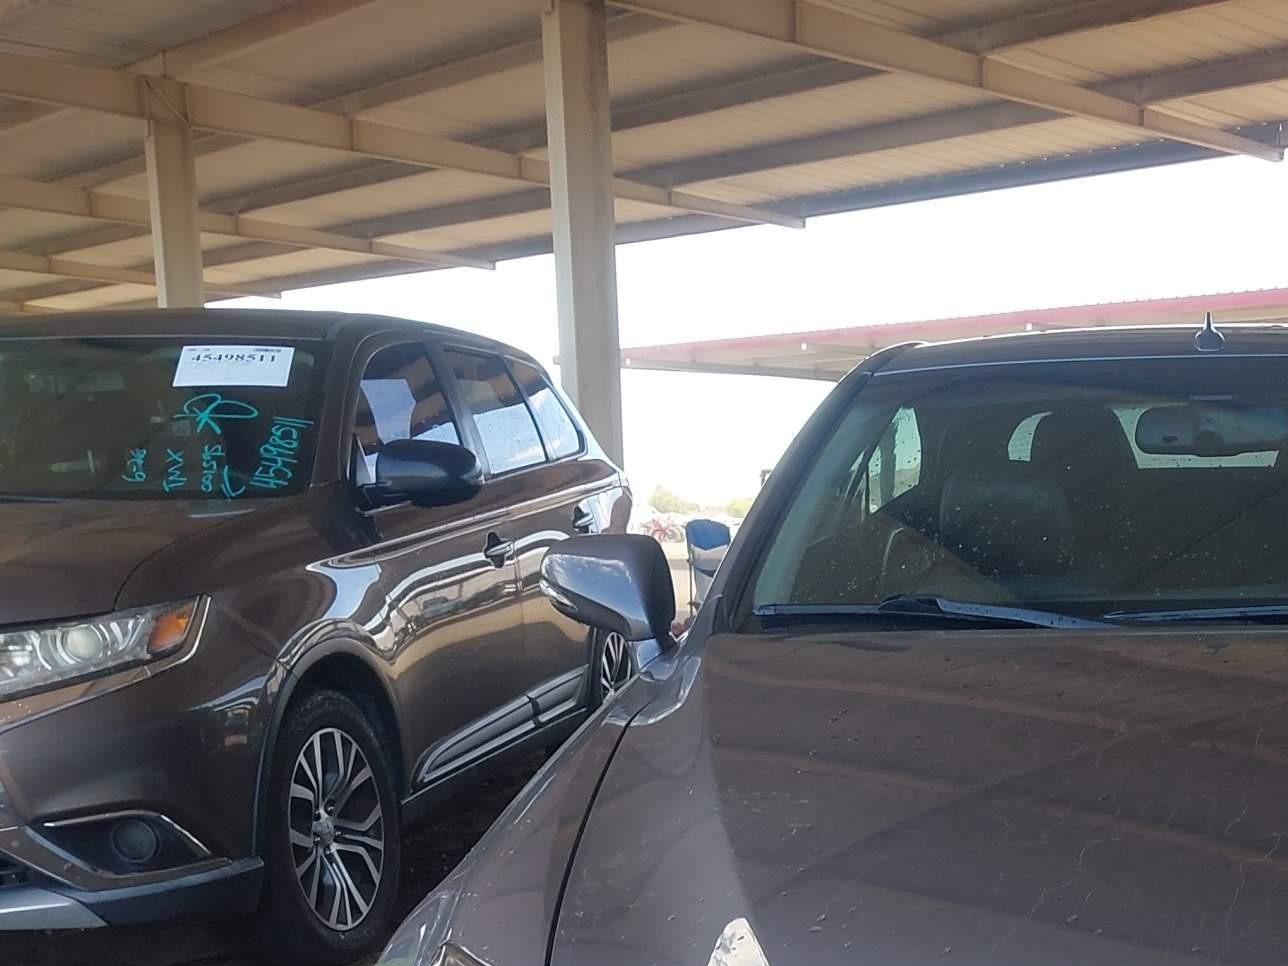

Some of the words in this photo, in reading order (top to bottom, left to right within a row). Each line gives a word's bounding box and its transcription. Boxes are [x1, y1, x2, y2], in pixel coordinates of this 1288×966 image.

[191, 353, 277, 363] 45498511
[162, 448, 188, 492] TMX
[250, 416, 315, 489] 45498511
